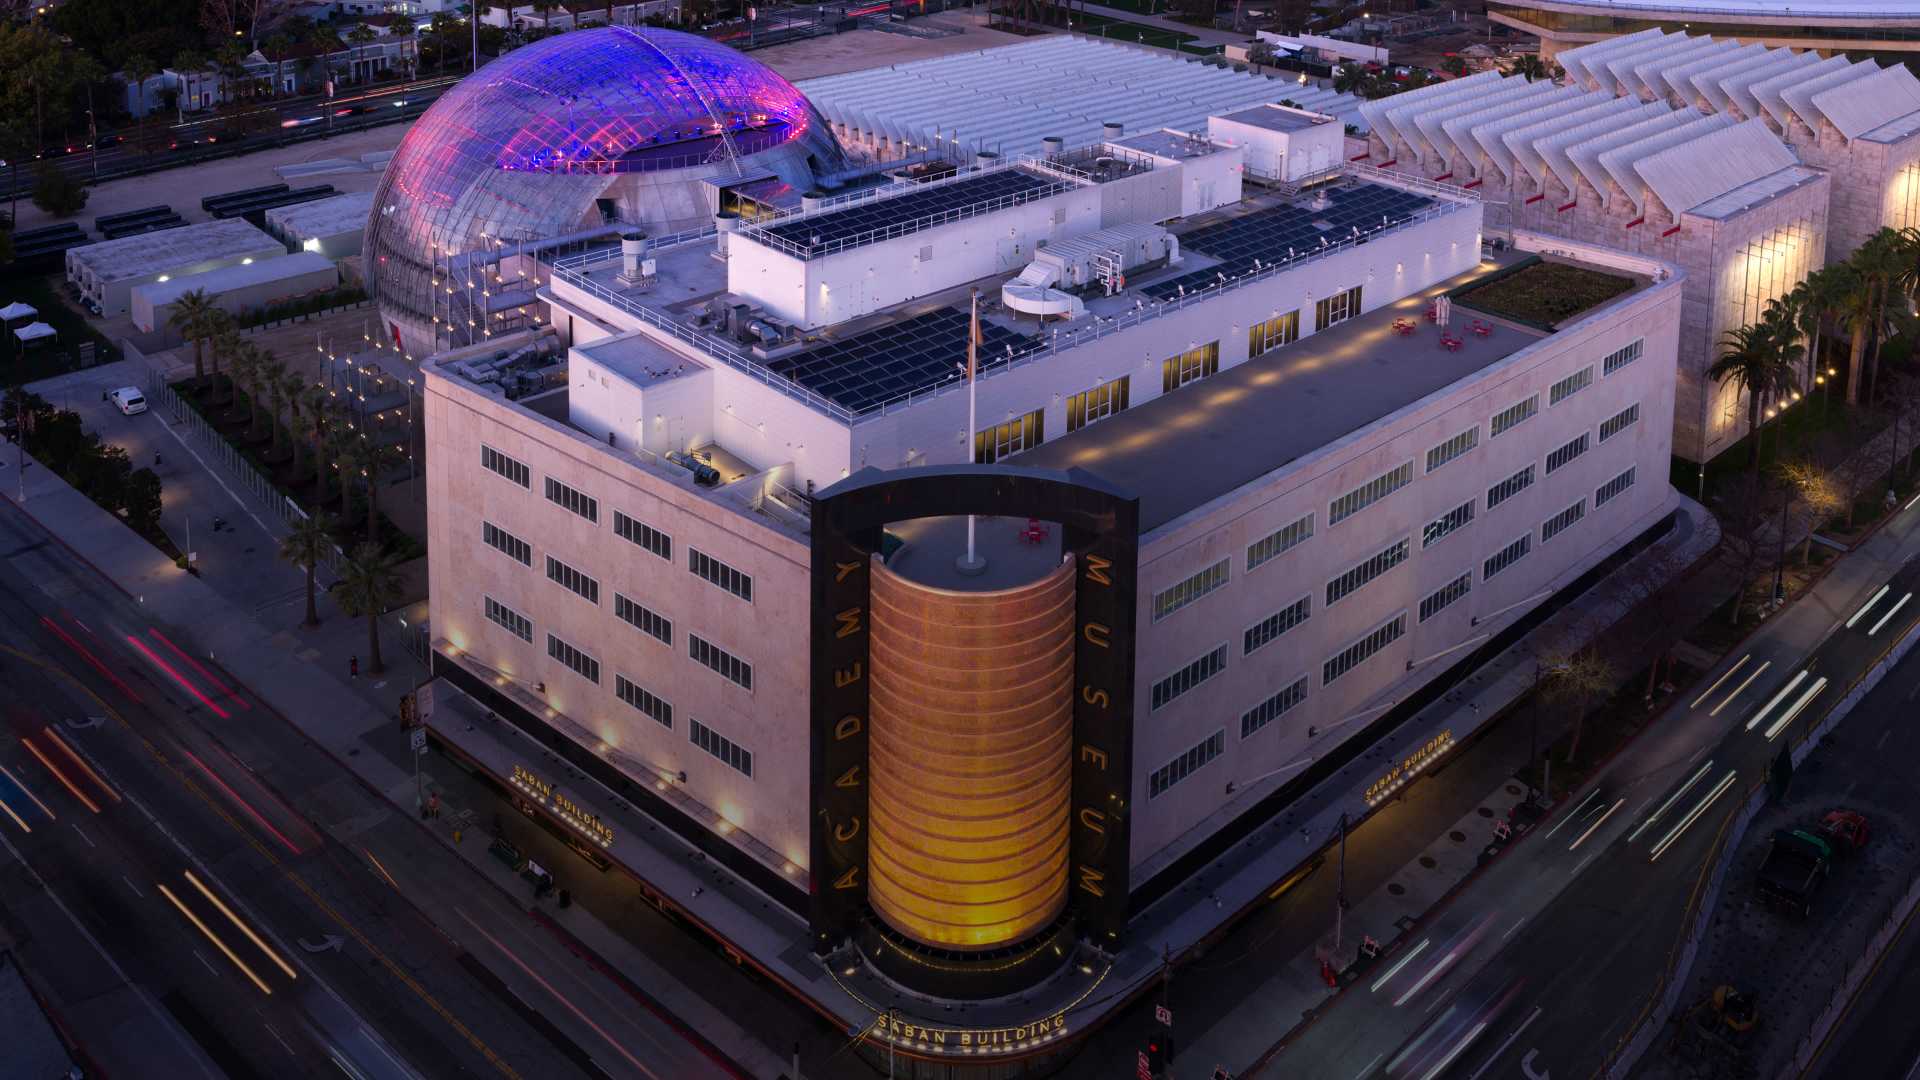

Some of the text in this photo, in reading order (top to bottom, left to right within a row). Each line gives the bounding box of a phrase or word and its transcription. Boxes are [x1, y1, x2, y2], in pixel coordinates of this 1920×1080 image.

[833, 560, 862, 890] ACADEMY
[1079, 553, 1112, 896] MUSEUM
[1404, 728, 1452, 769] BUILDING
[513, 765, 614, 843] SABAN BUILDING
[877, 1014, 1065, 1046] SABAN BUILDING
